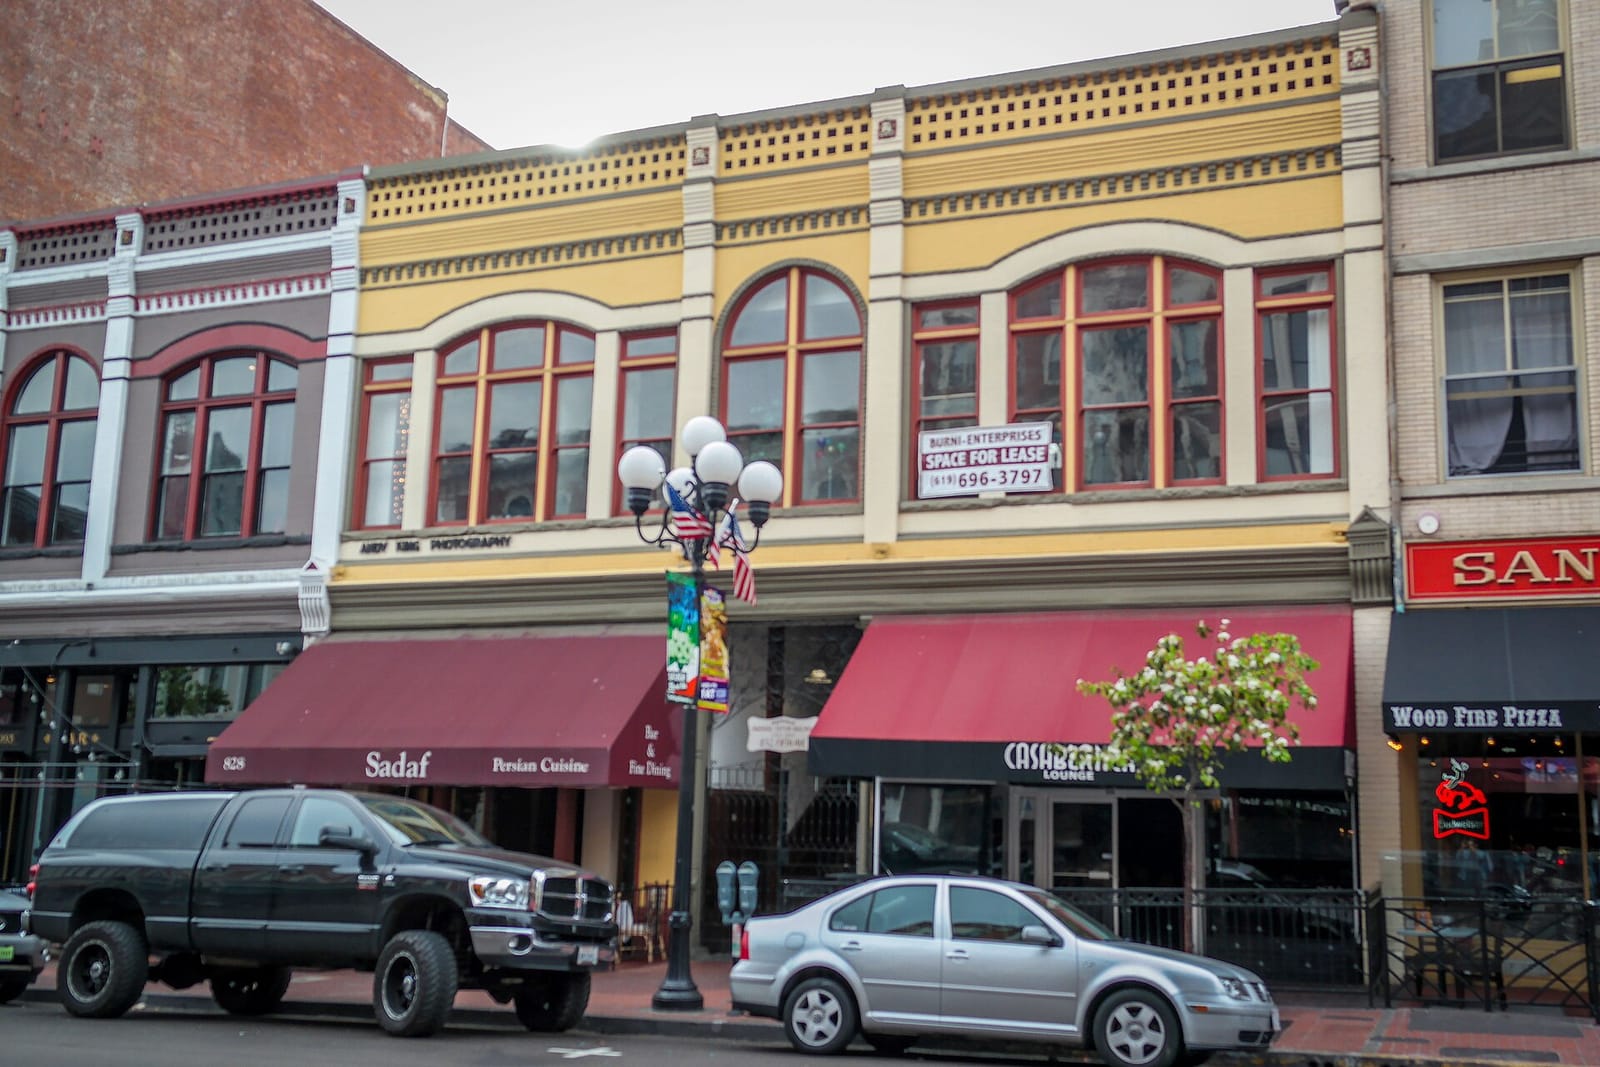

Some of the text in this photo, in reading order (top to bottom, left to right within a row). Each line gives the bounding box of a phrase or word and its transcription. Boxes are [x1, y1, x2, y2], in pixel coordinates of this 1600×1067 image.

[929, 430, 1042, 448] BURNI-ENTERPRISES
[925, 446, 1046, 469] SPACE FOR LEASE
[930, 469, 1042, 487] (619) 696-3797
[430, 536, 512, 550] PHOTOGRAPHY
[1453, 548, 1599, 585] SAN
[644, 724, 659, 740] Bar
[646, 742, 656, 758] &
[222, 756, 246, 771] 828
[365, 751, 432, 778] Sadaf
[492, 757, 590, 773] Persian Cuisine
[1042, 770, 1095, 781] LOUNGE
